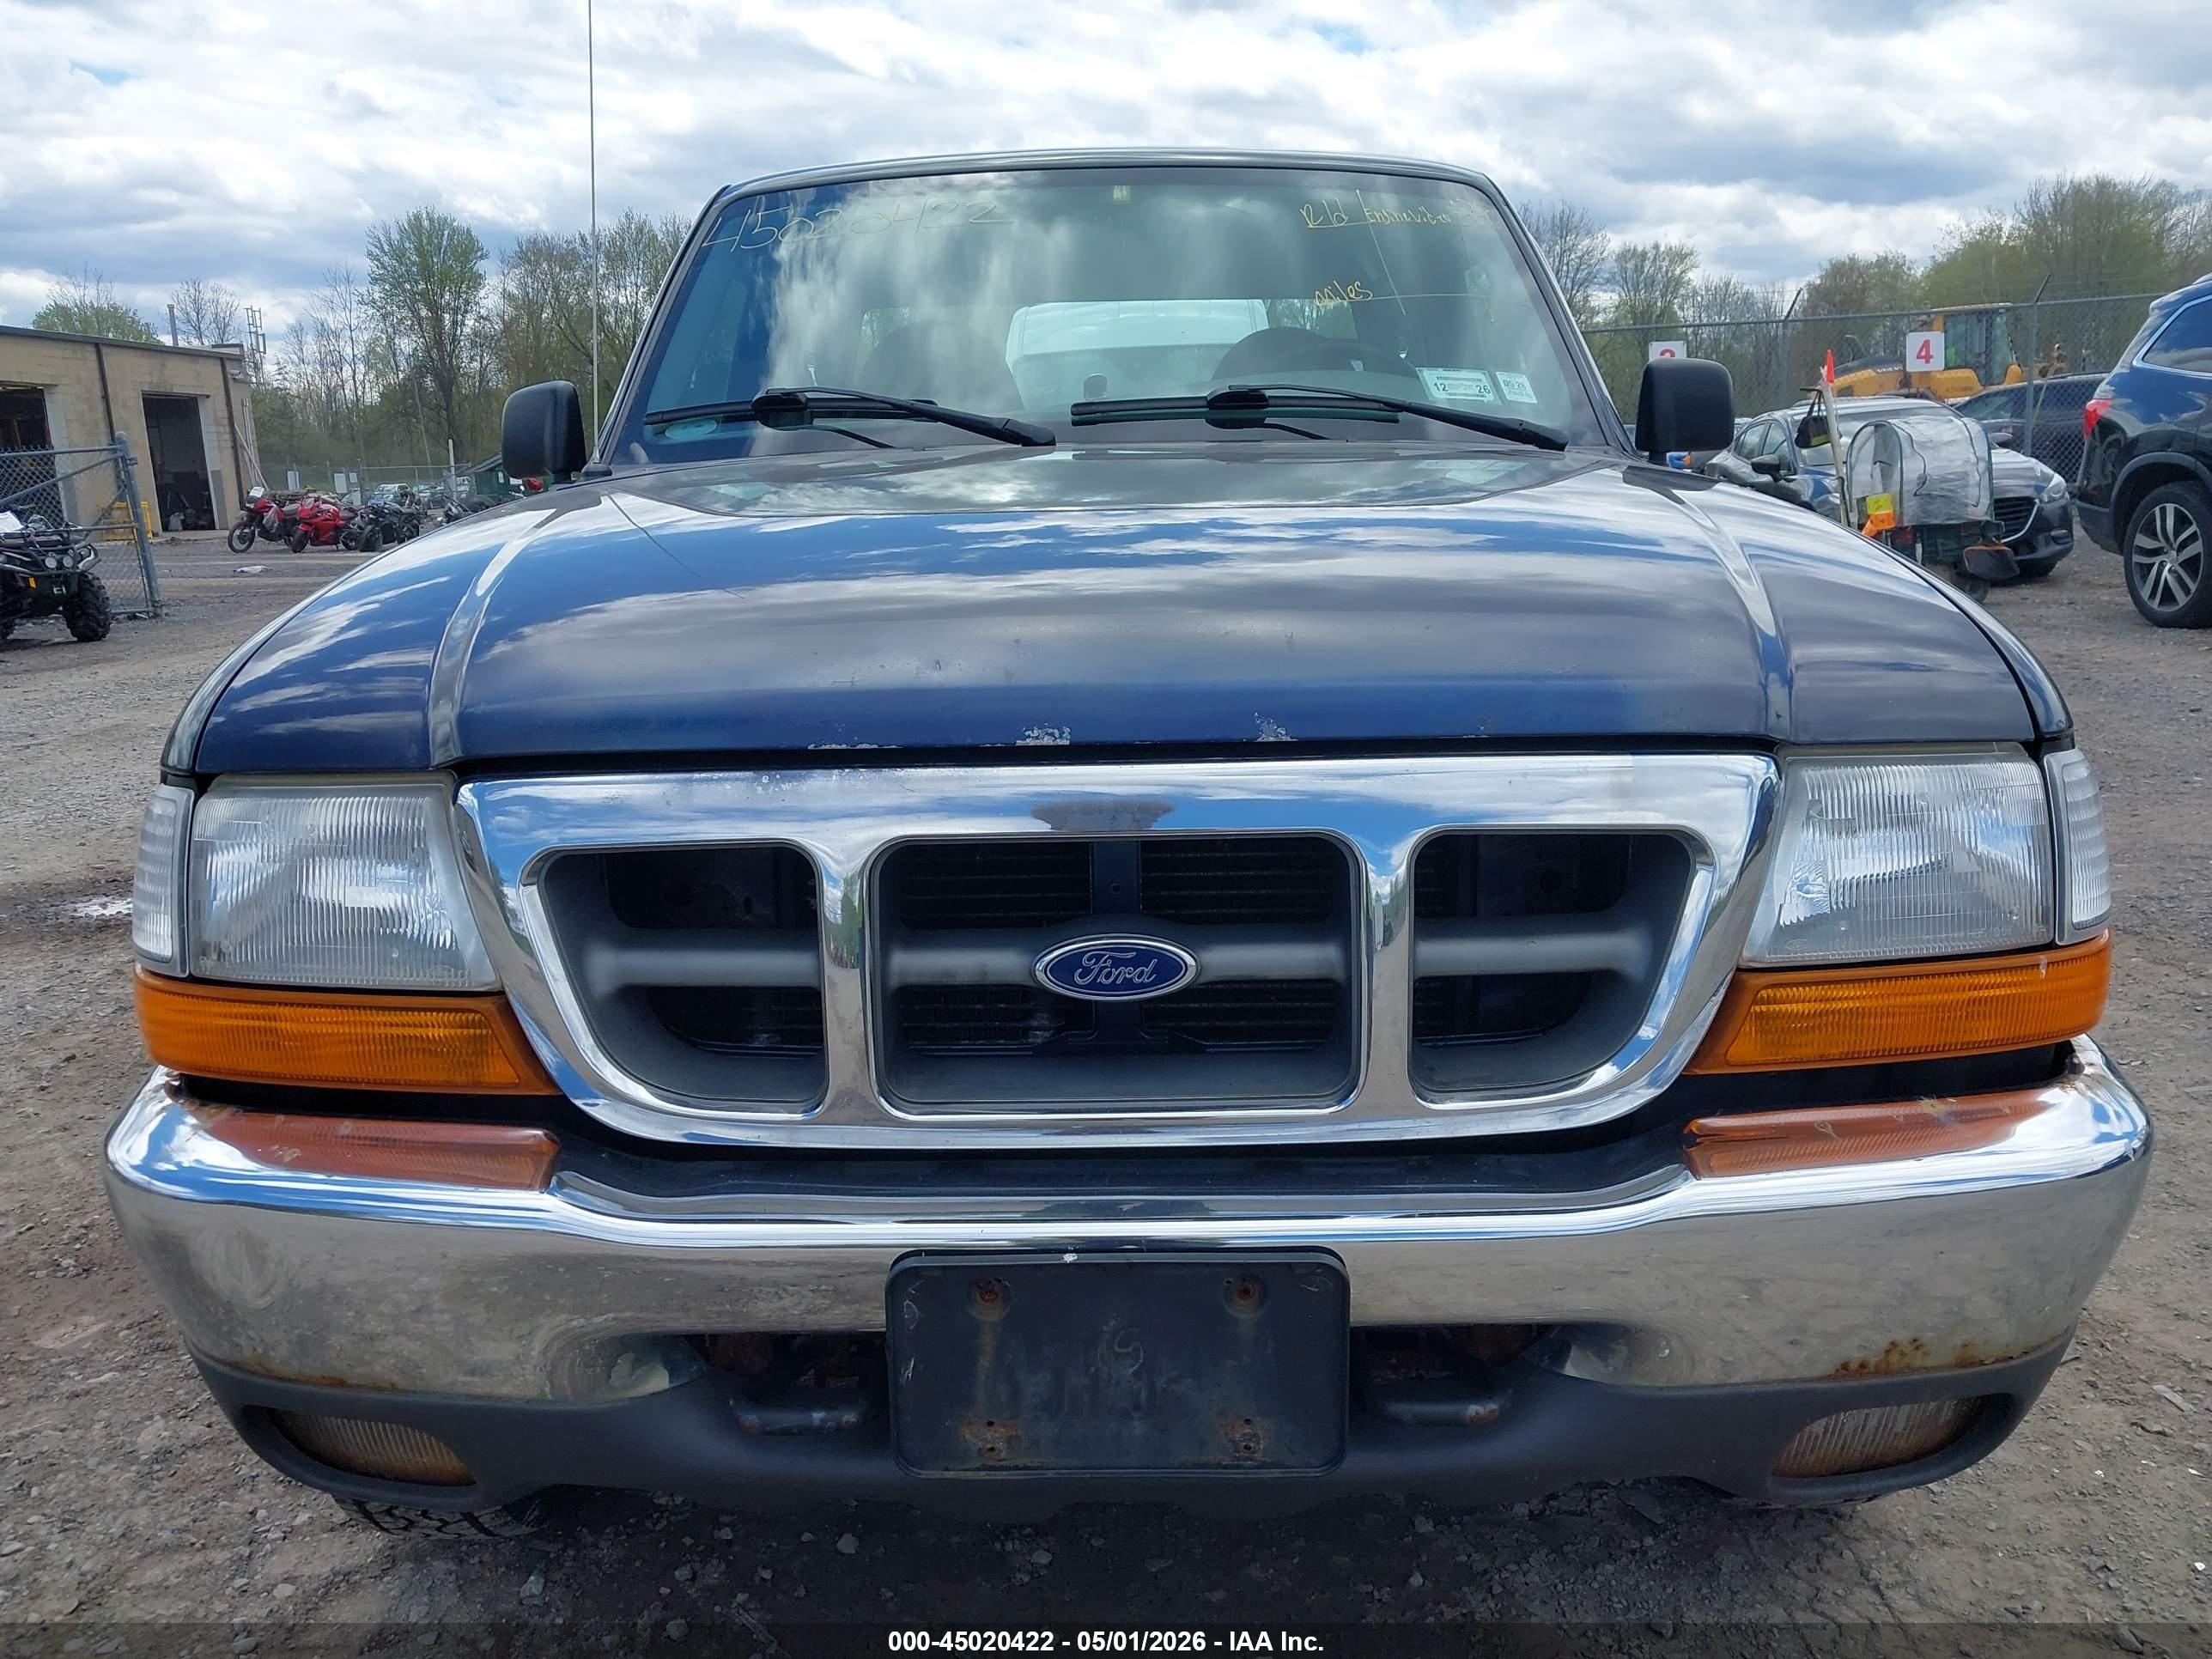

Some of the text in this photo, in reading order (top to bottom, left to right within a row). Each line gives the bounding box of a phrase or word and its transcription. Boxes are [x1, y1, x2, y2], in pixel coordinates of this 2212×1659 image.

[702, 196, 1014, 253] 45020422
[1916, 338, 1934, 365] 4
[1433, 383, 1449, 392] 12
[1475, 385, 1492, 394] 26
[1073, 951, 1158, 986] Ford
